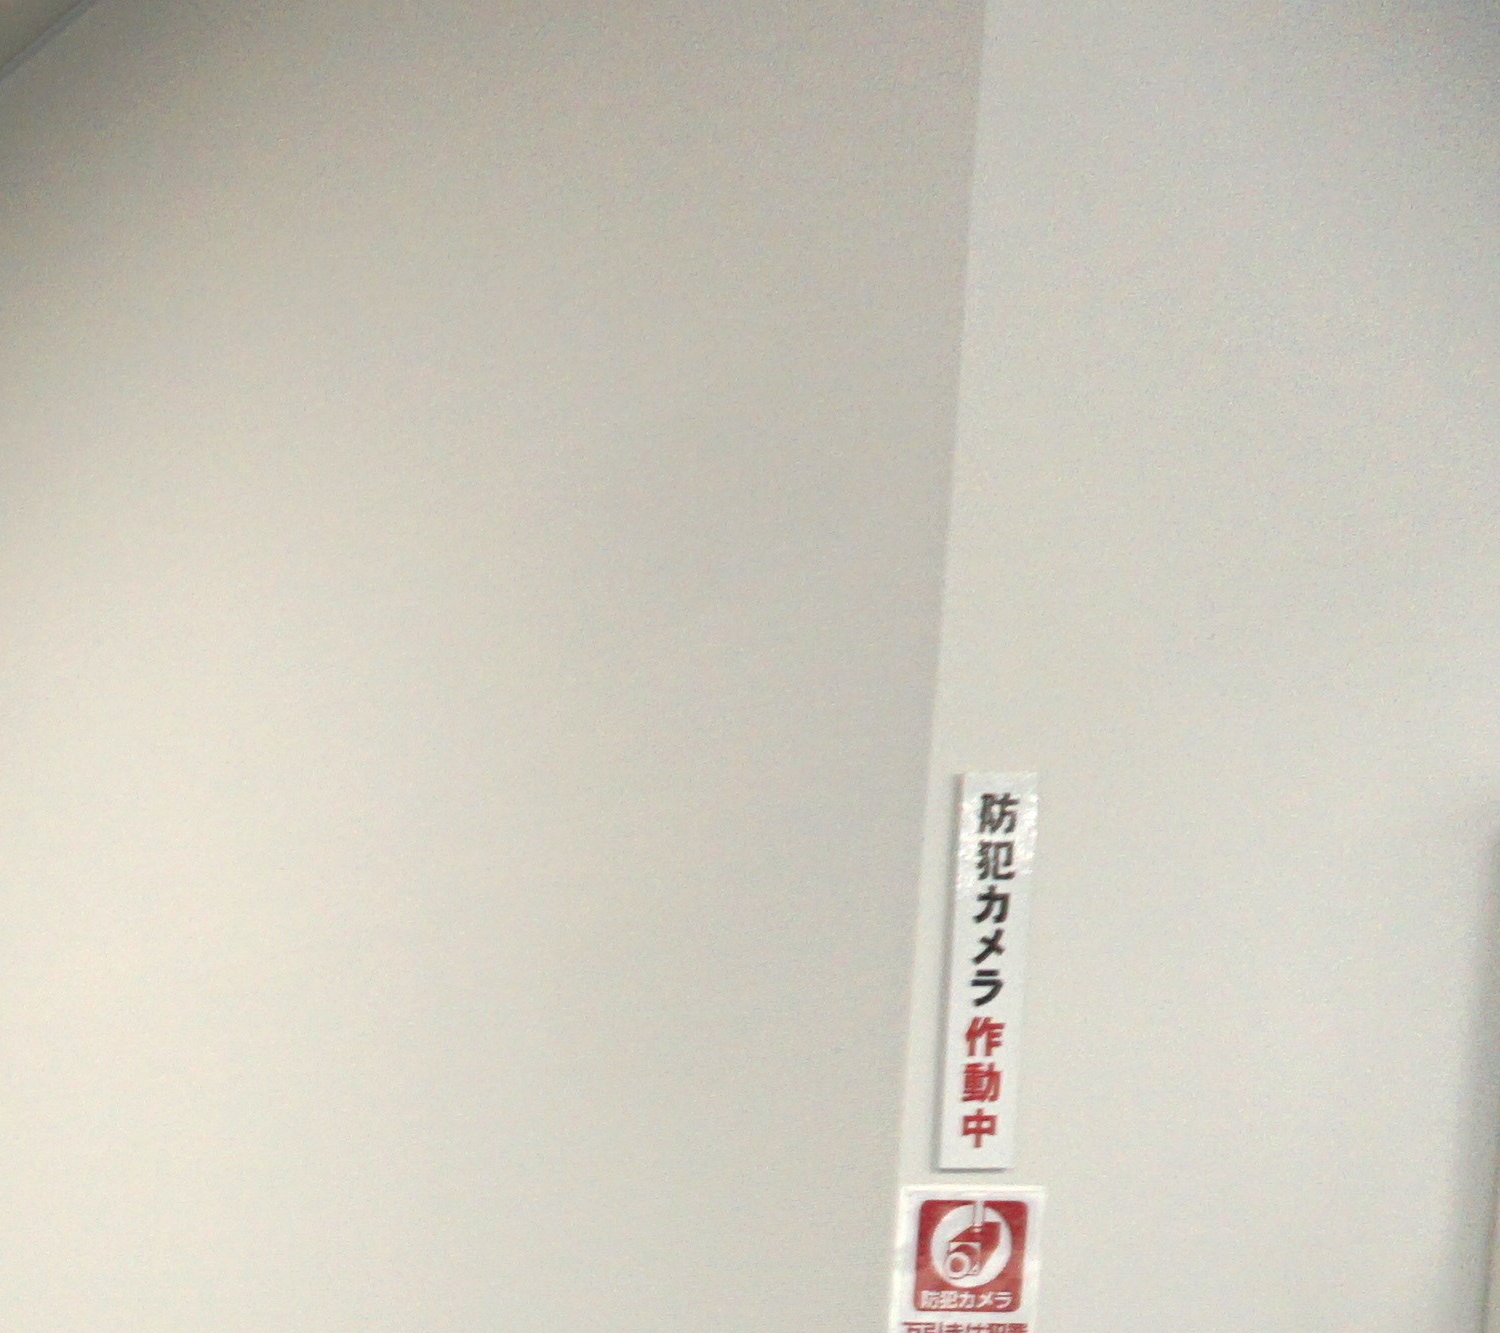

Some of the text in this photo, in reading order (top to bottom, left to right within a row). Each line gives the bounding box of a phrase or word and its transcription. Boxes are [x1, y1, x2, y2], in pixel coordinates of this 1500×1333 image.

[961, 792, 1019, 1148] 防犯カメラ作動中
[920, 1290, 1013, 1309] 防犯カメラ
